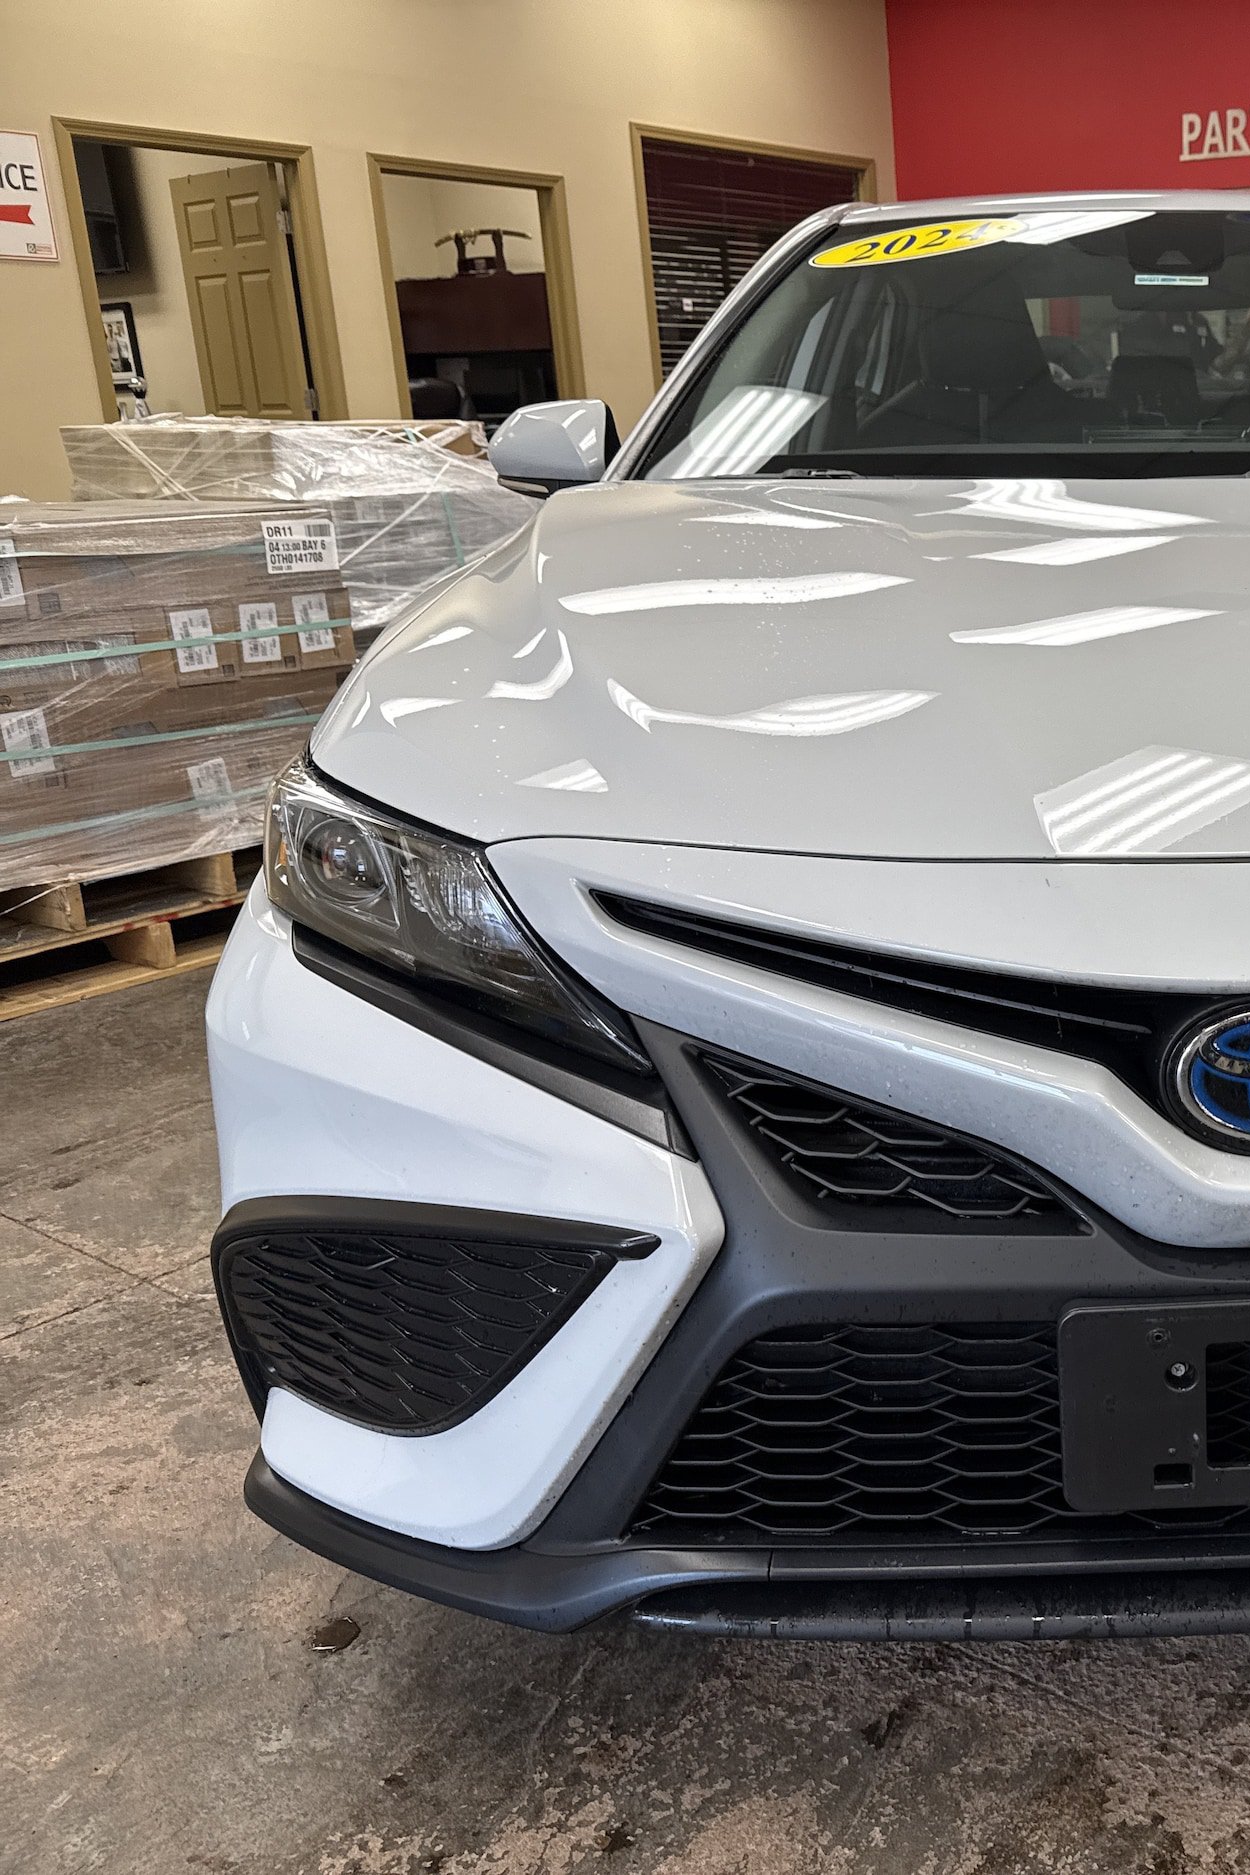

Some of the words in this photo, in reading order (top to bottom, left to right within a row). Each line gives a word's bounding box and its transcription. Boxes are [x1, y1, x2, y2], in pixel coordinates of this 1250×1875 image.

[845, 222, 993, 263] 2024
[266, 526, 293, 538] DR11
[269, 542, 280, 552] 04
[302, 540, 318, 551] BAY
